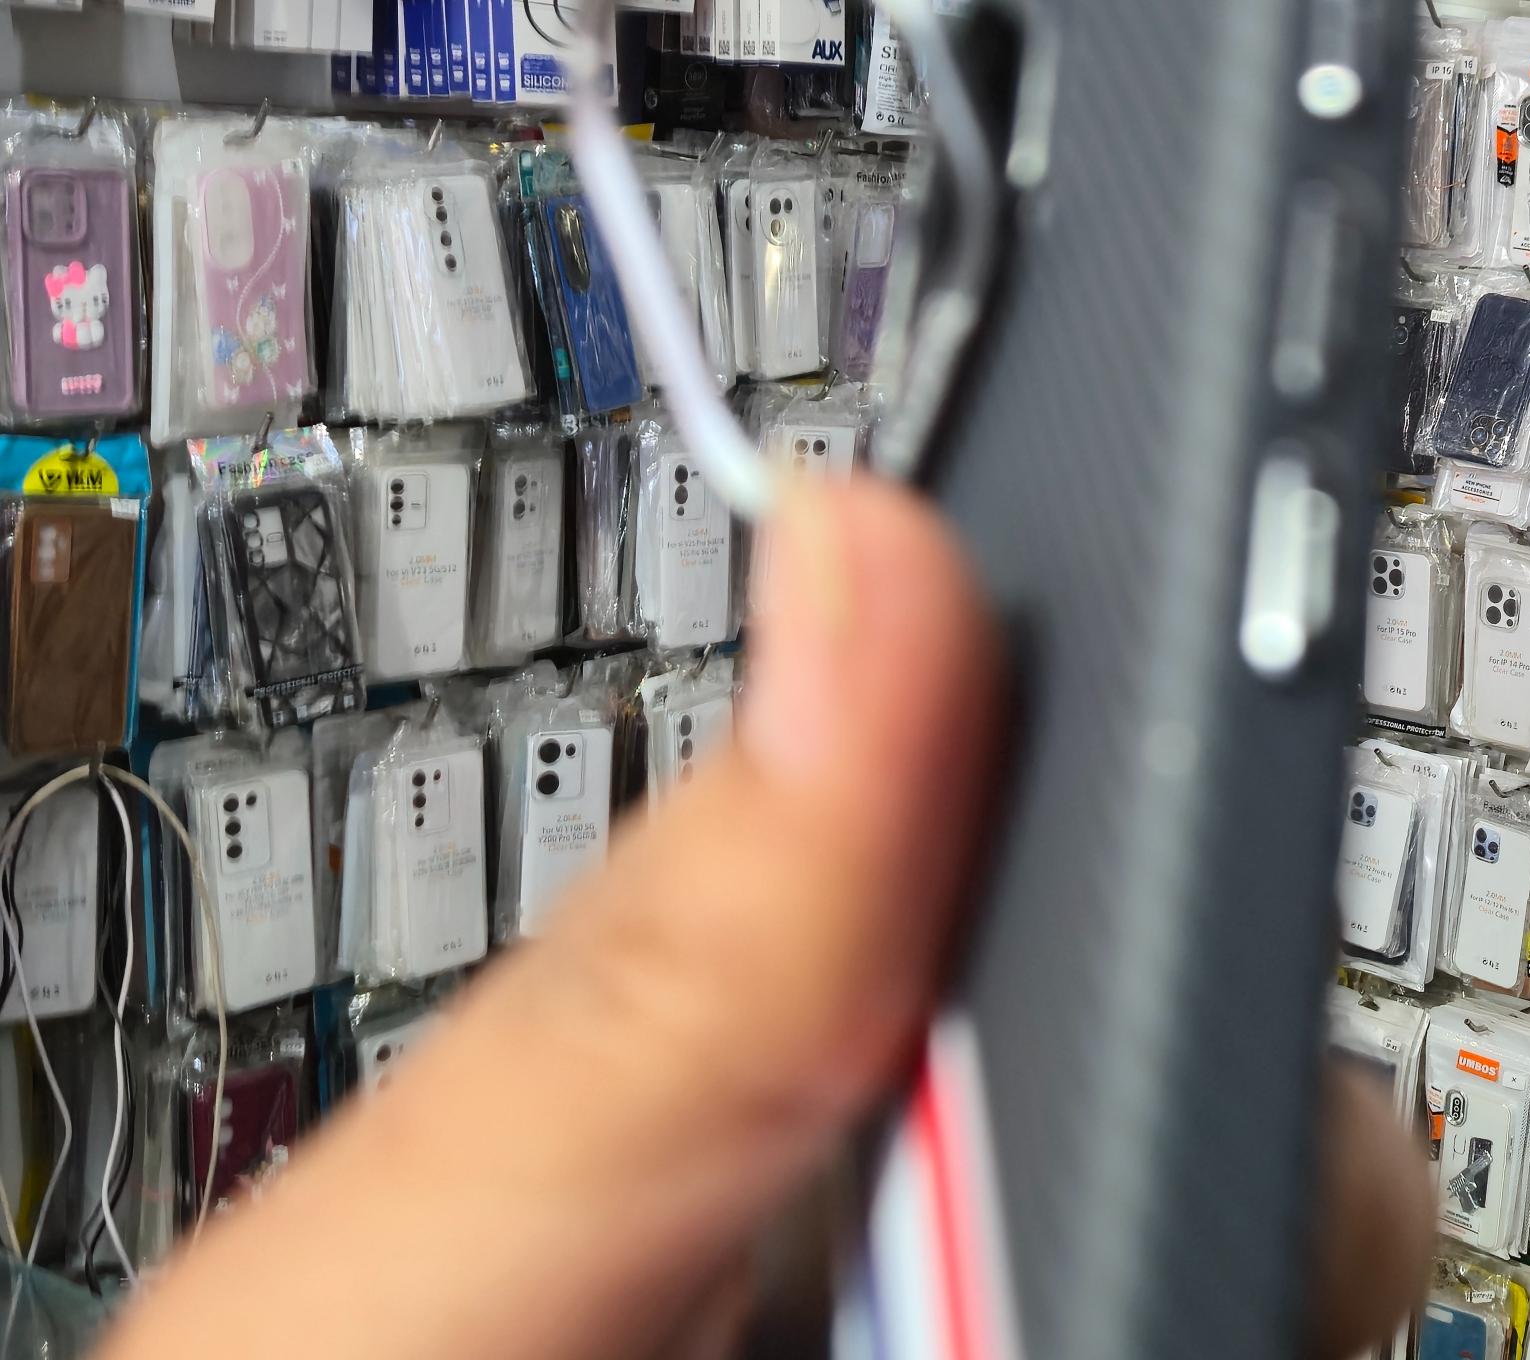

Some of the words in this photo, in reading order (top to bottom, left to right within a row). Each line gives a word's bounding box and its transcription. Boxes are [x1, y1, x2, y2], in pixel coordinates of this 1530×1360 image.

[812, 38, 843, 61] AUX
[1488, 656, 1499, 664] For
[1519, 663, 1530, 671] Pro
[1459, 1056, 1496, 1075] UMBOS
